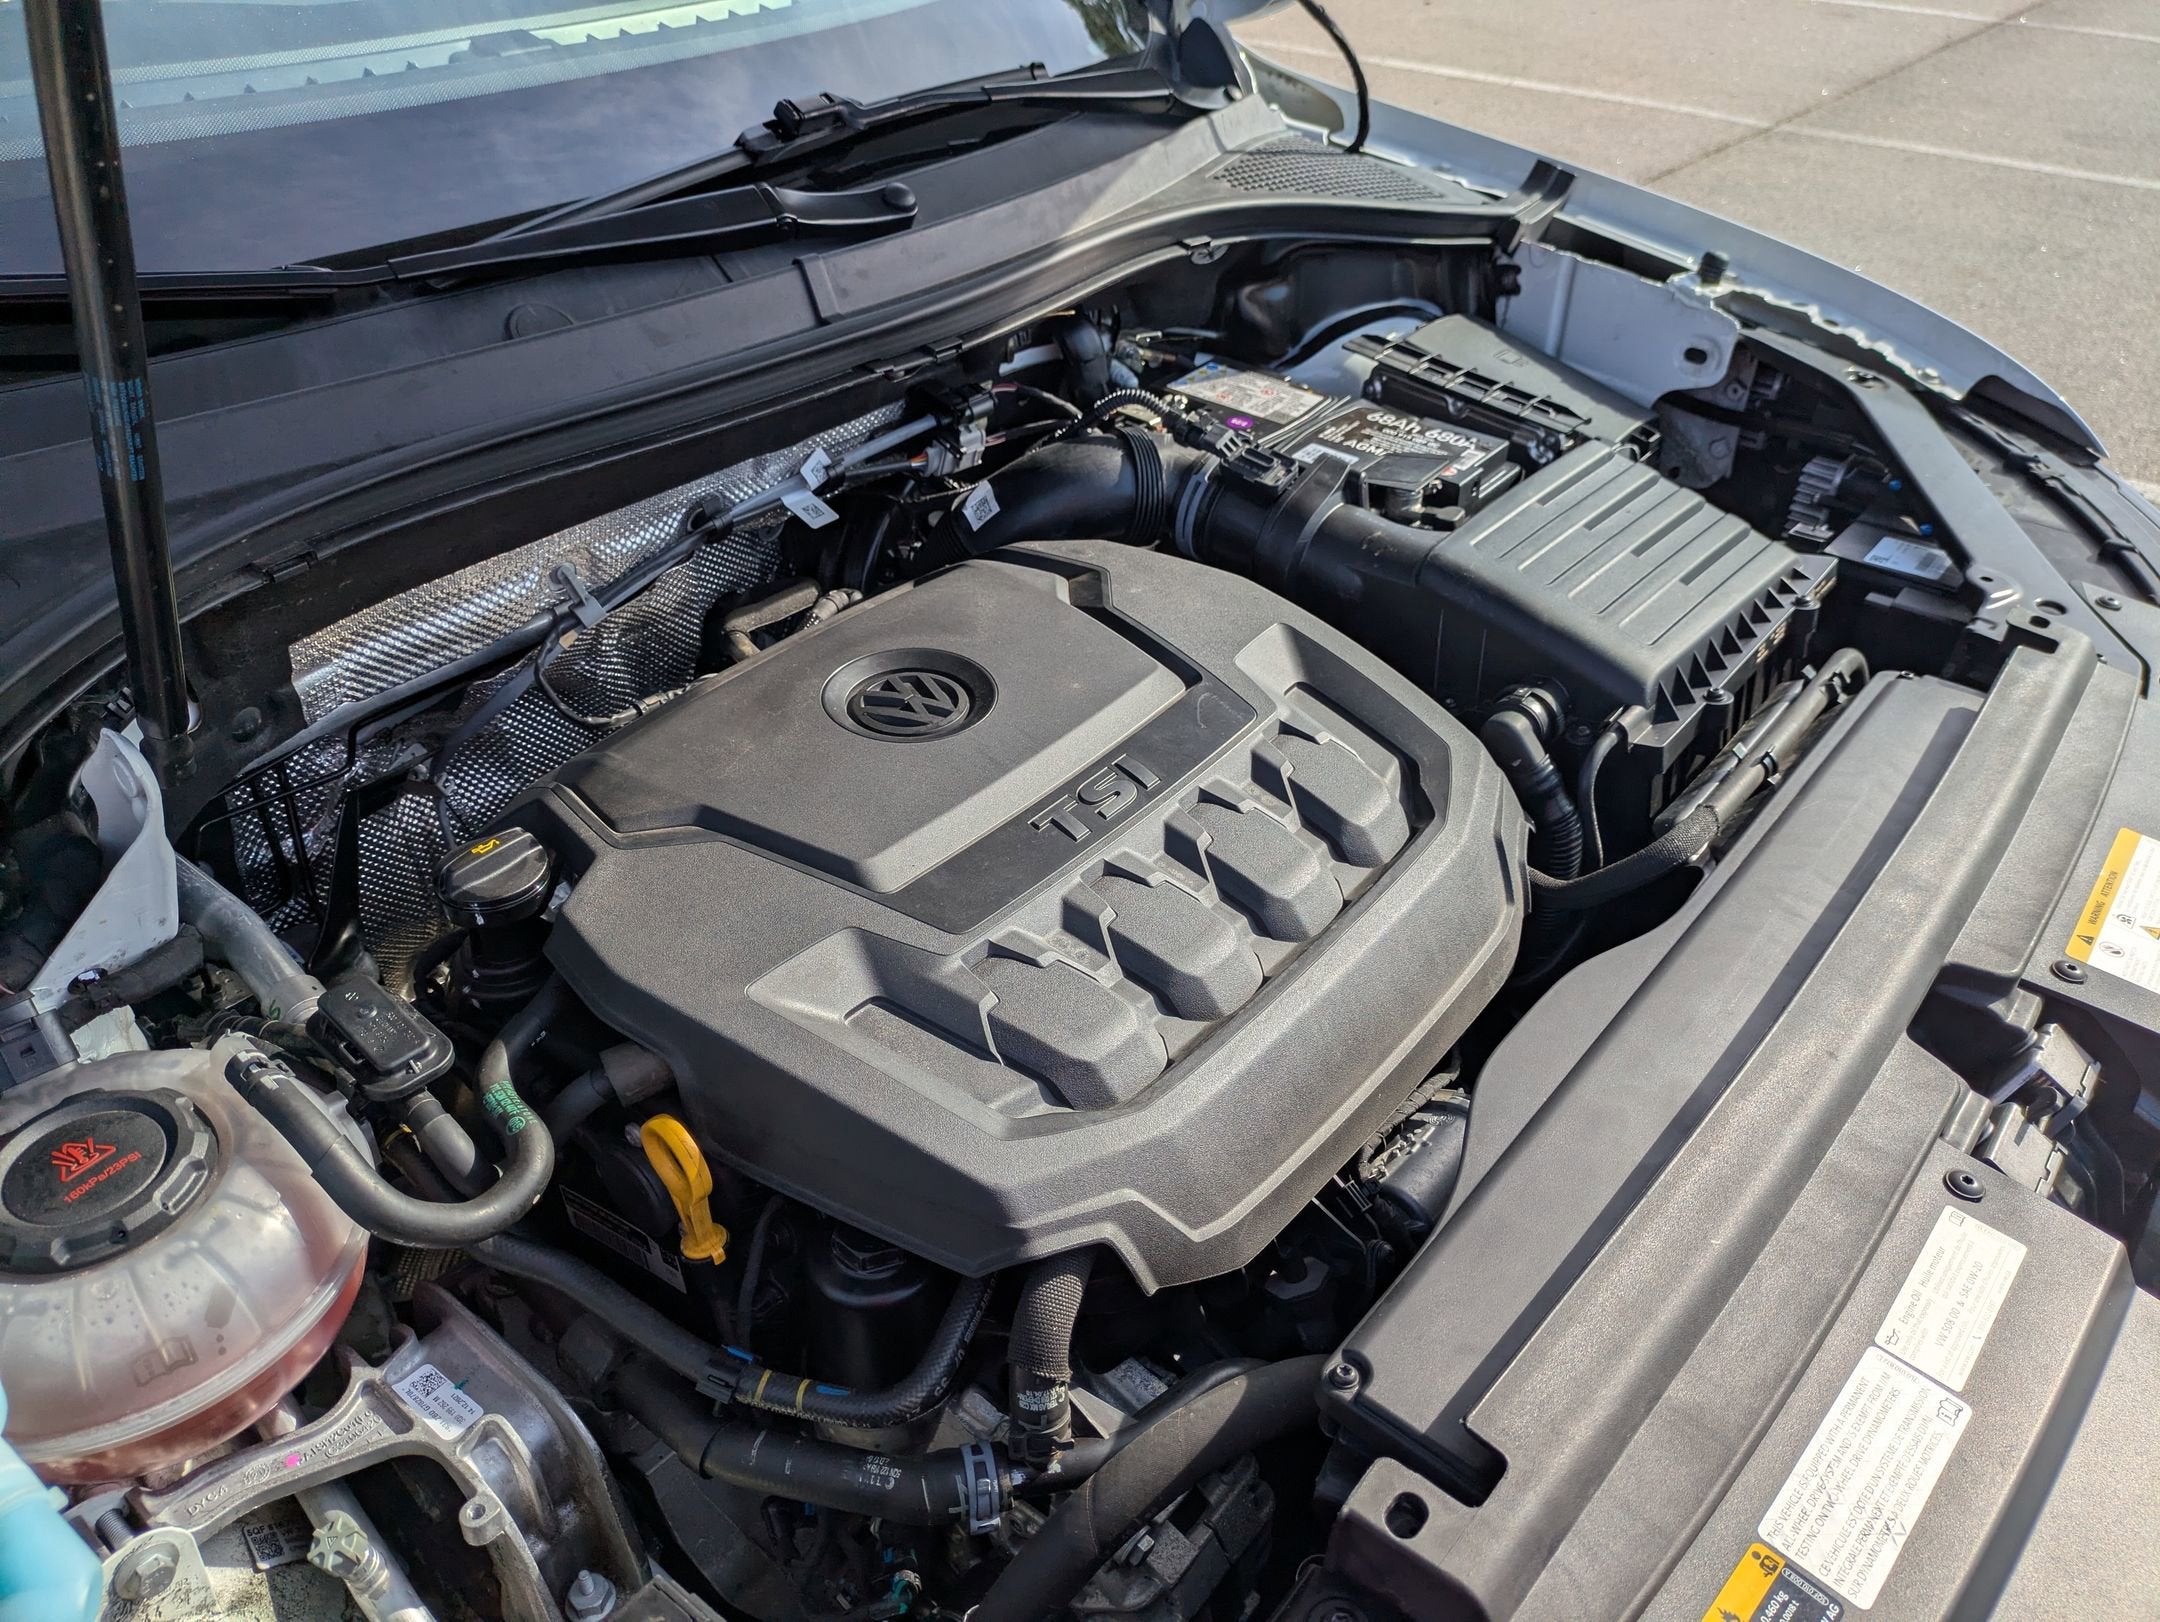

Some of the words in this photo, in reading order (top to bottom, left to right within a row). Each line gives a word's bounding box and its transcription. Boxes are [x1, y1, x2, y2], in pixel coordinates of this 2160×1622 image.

[1367, 411, 1421, 434] 68Ah
[1425, 428, 1478, 451] 680A
[1027, 754, 1161, 842] TSI
[2088, 901, 2105, 925] WARNING
[2100, 870, 2118, 898] ATTENTION
[63, 1151, 142, 1203] 160kPa/23PSI
[1898, 1299, 1918, 1325] Engine
[1908, 1287, 1922, 1302] Oil
[1958, 1283, 1972, 1299] SAE
[1940, 1317, 1956, 1334] 508
[1947, 1305, 1961, 1320] 00
[1934, 1330, 1949, 1348] VW
[1838, 1374, 1871, 1420] PERMANENT
[1896, 1383, 1931, 1436] TRANSMISSION
[1823, 1422, 1842, 1446] WITH
[1835, 1416, 1846, 1426] A
[1890, 1431, 1905, 1446] DE
[1779, 1505, 1812, 1552] ALL-WHEEL
[1805, 1481, 1826, 1508] DRIVE
[1835, 1437, 1853, 1457] AND
[1850, 1402, 1873, 1432] EXEMPT
[1866, 1382, 1885, 1405] FROM
[1794, 1524, 1821, 1561] TESTING
[1813, 1510, 1829, 1528] ON
[1848, 1441, 1869, 1468] DRIVE
[1861, 1385, 1901, 1445] DYNAMOMETERS
[1801, 1441, 1832, 1483] EQUIPPED
[1777, 1486, 1804, 1524] VEHICLE
[247, 1525, 266, 1537] 5QF
[1766, 1519, 1785, 1542] THIS
[1846, 1576, 1864, 1599] SUR
[1892, 1488, 1912, 1513] DEUX
[1904, 1463, 1925, 1491] ROUES
[1773, 1590, 1789, 1604] kg
[1826, 1603, 1840, 1621] AG
